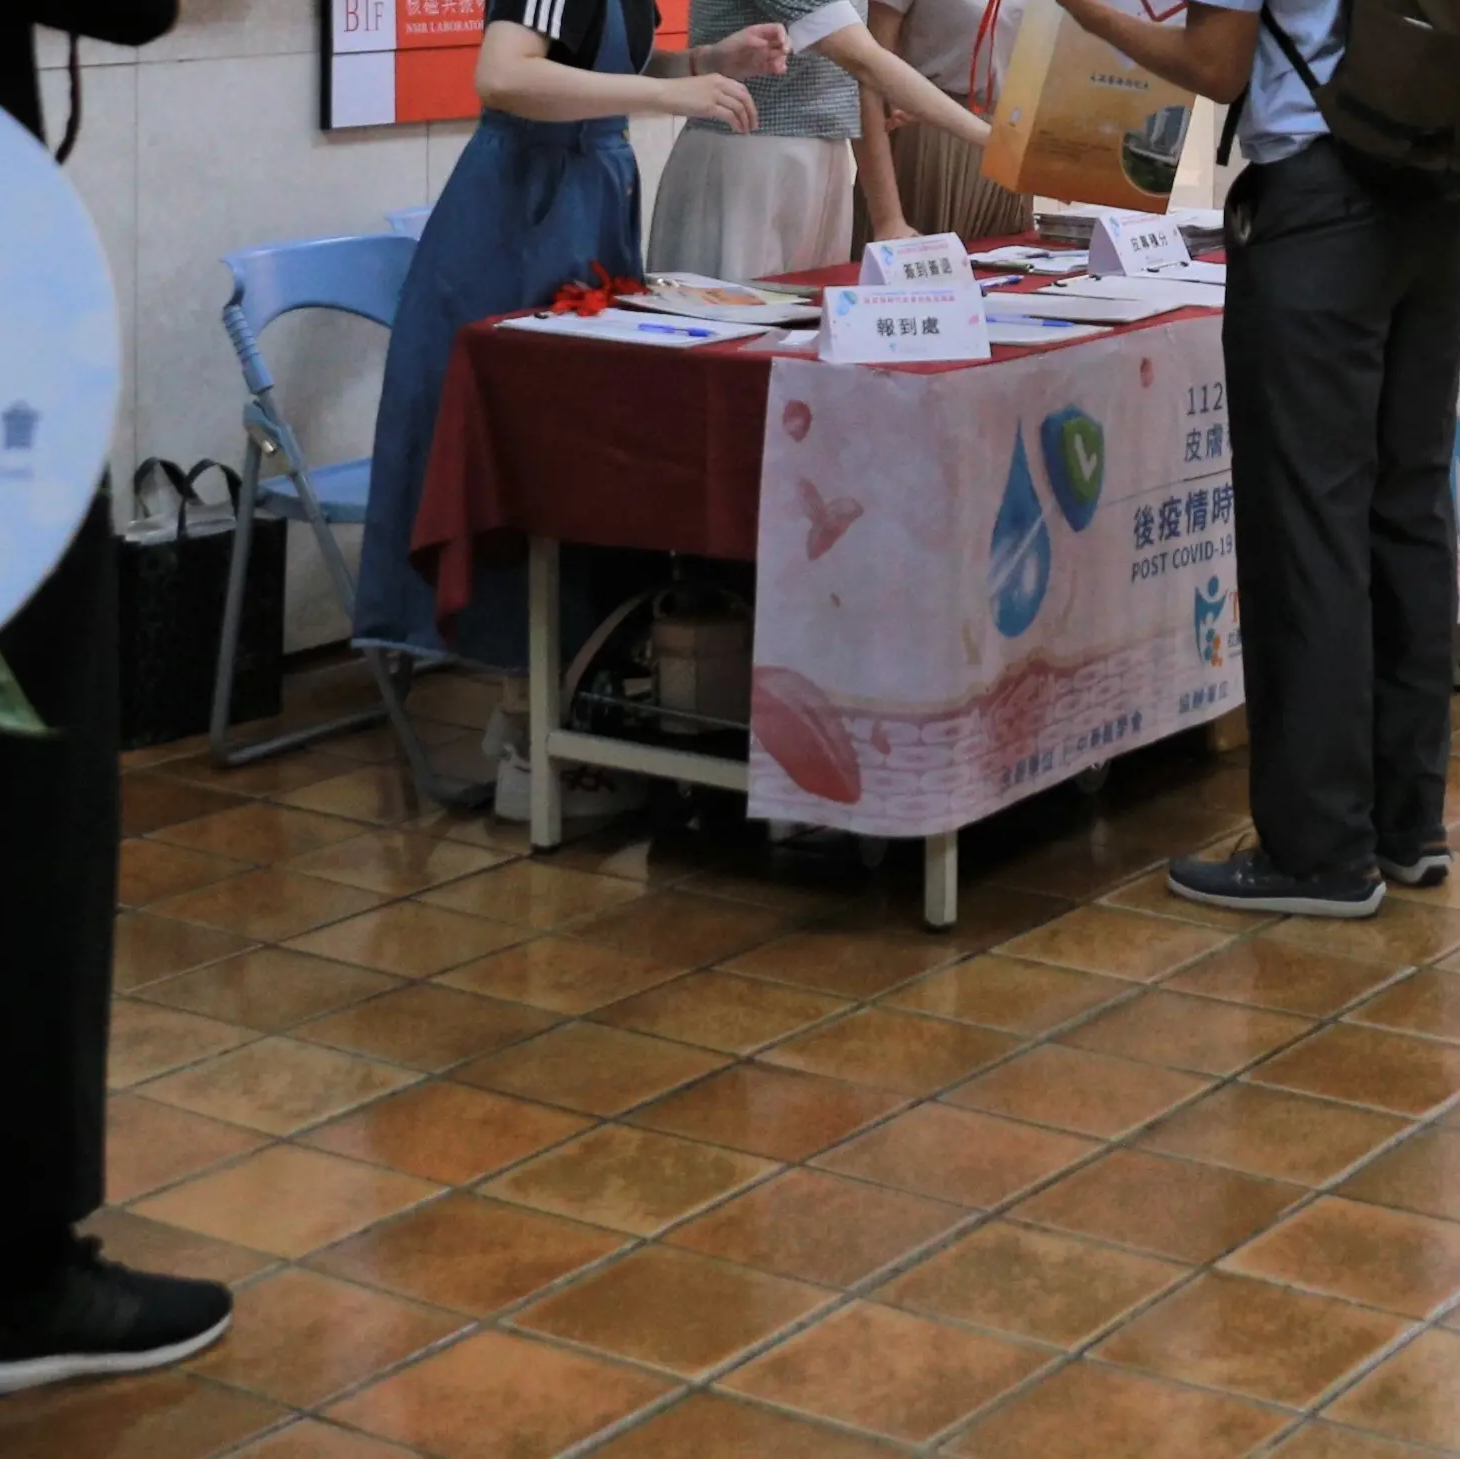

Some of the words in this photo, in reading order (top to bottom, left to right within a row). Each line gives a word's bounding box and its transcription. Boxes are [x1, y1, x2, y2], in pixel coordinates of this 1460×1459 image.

[406, 22, 429, 33] NMR
[876, 316, 940, 337] 報到處
[1186, 383, 1223, 416] 112
[1184, 423, 1231, 462] 皮膚
[1131, 552, 1169, 583] POST
[1172, 534, 1233, 570] COVID-19
